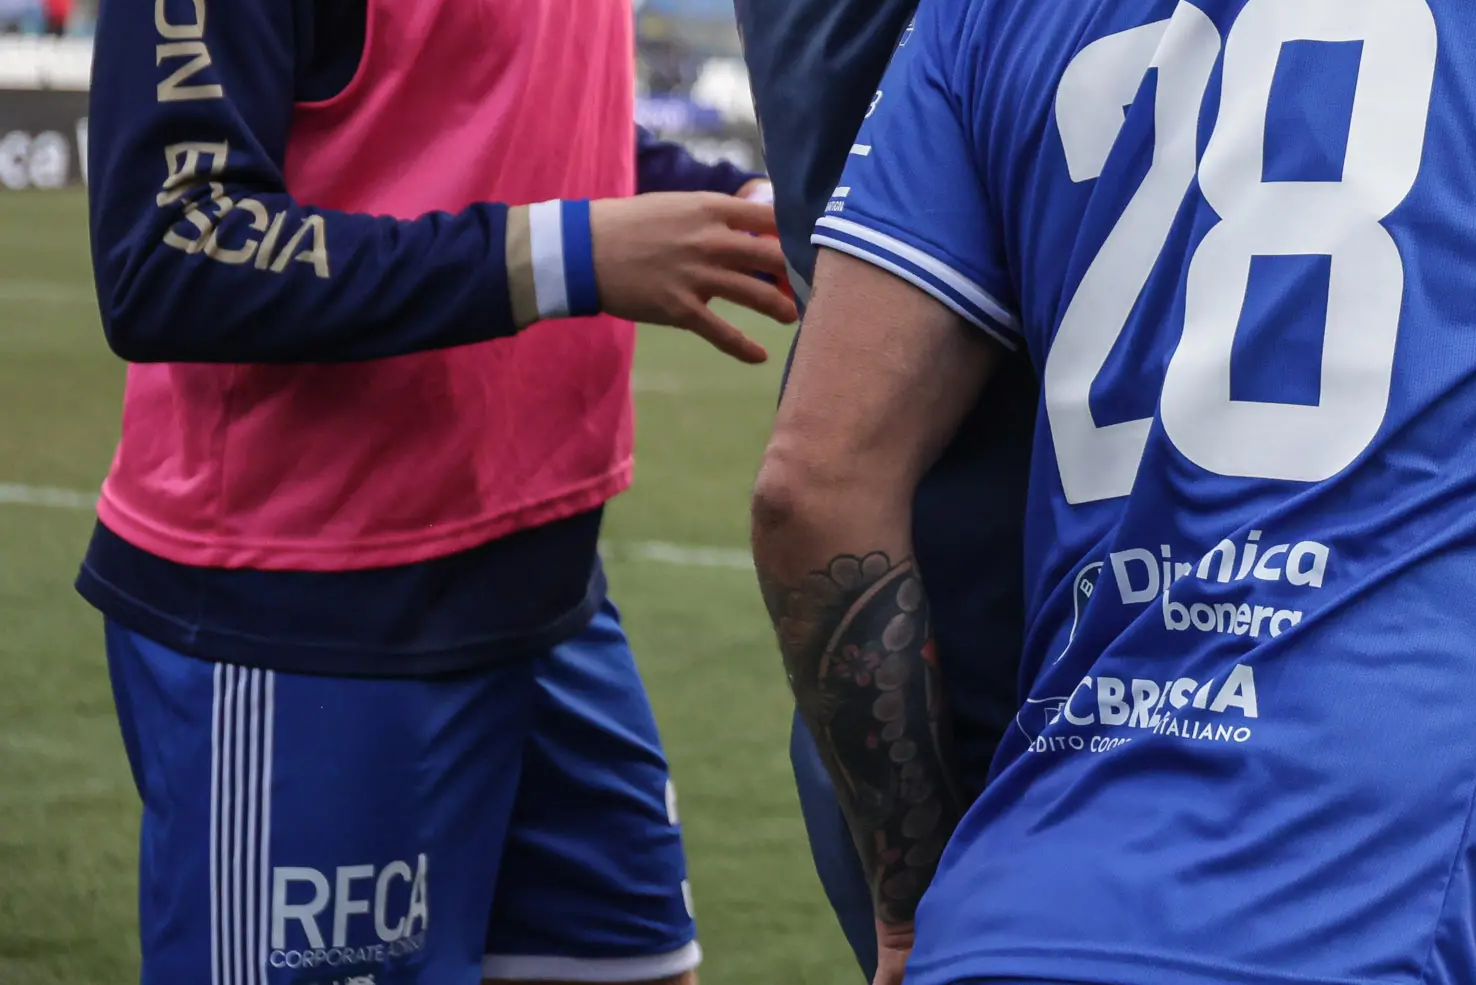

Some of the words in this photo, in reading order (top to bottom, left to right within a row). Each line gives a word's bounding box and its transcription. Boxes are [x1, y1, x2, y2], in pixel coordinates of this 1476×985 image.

[1162, 589, 1302, 638] bonera
[271, 853, 428, 950] RFCA
[270, 944, 385, 968] CORPORATE
